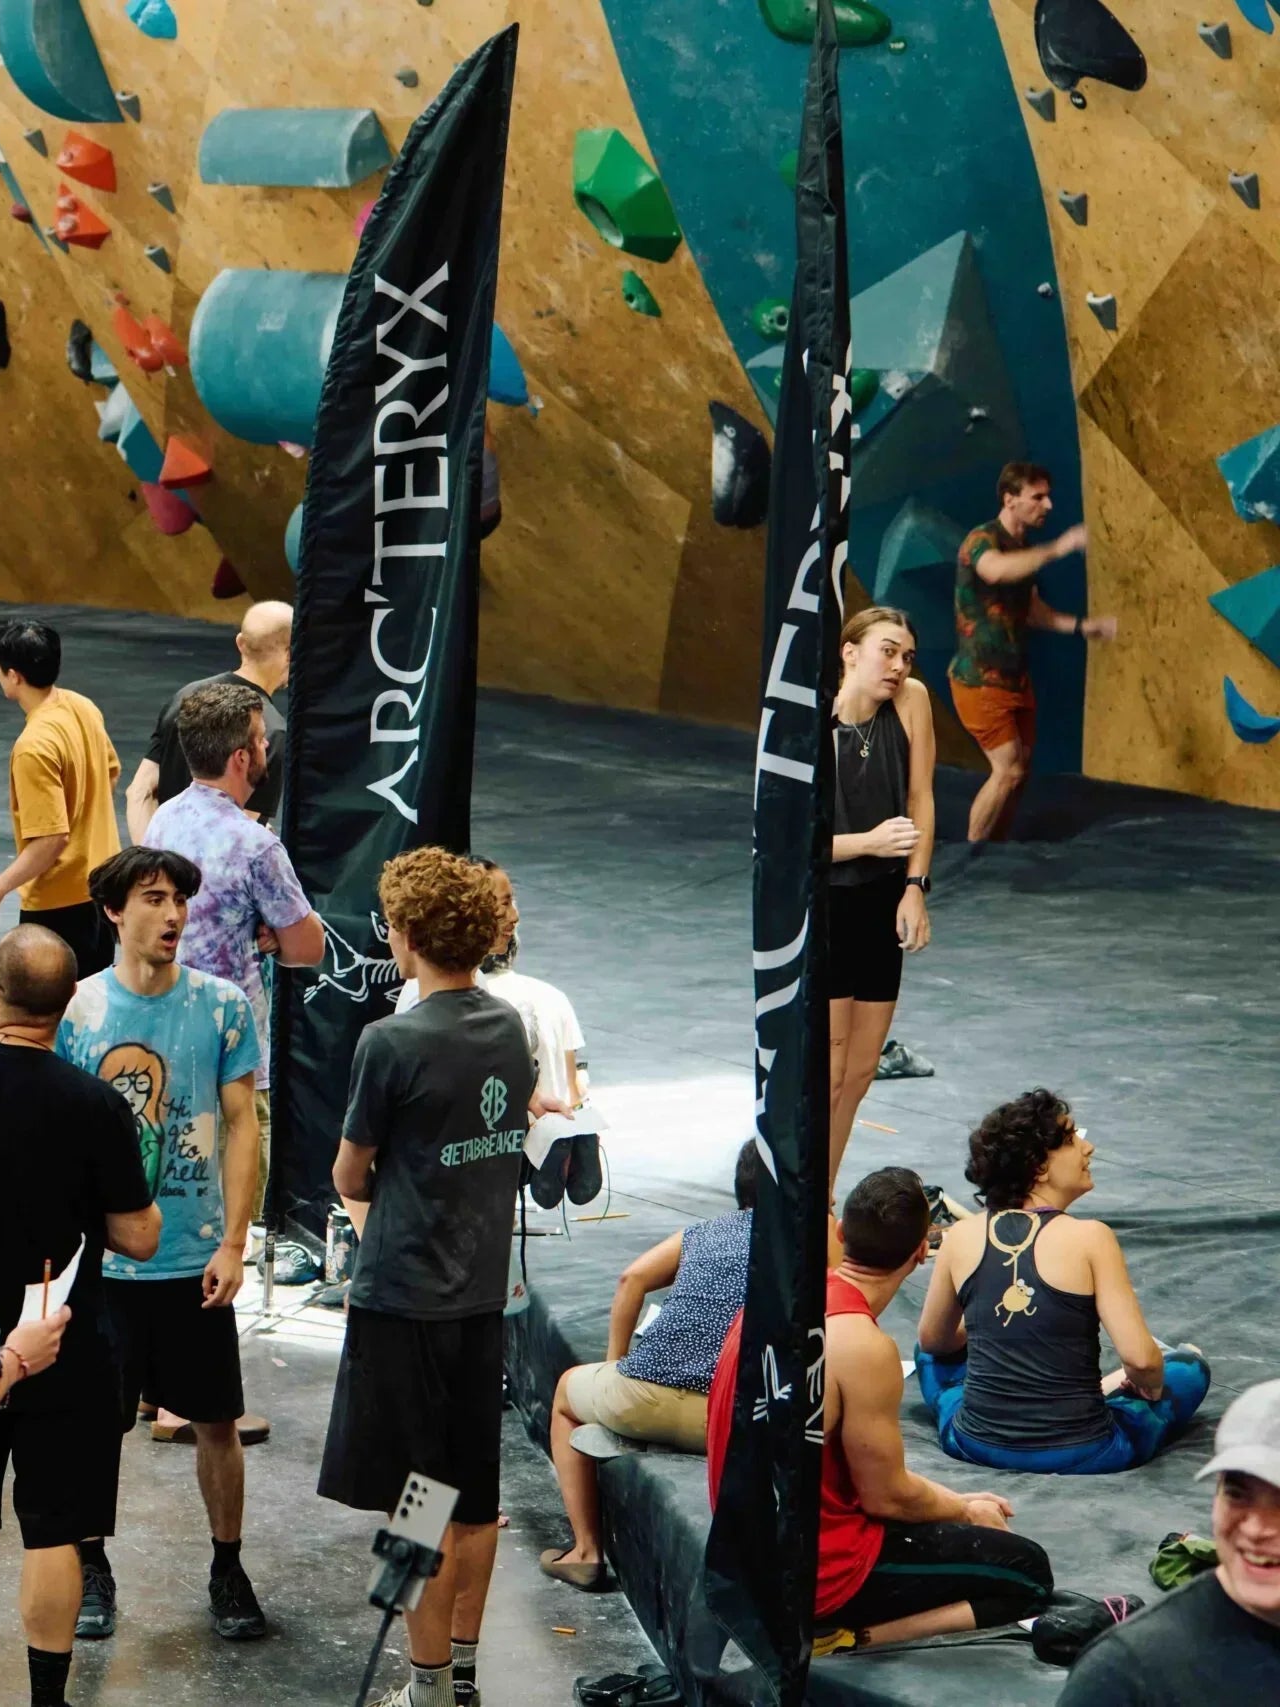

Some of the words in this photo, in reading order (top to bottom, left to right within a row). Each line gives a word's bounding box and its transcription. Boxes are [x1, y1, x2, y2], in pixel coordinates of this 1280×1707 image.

[364, 260, 449, 825] ARC'TERYX
[162, 1096, 192, 1119] Hi,
[168, 1122, 196, 1154] go
[177, 1139, 200, 1159] to
[162, 1156, 210, 1182] hell
